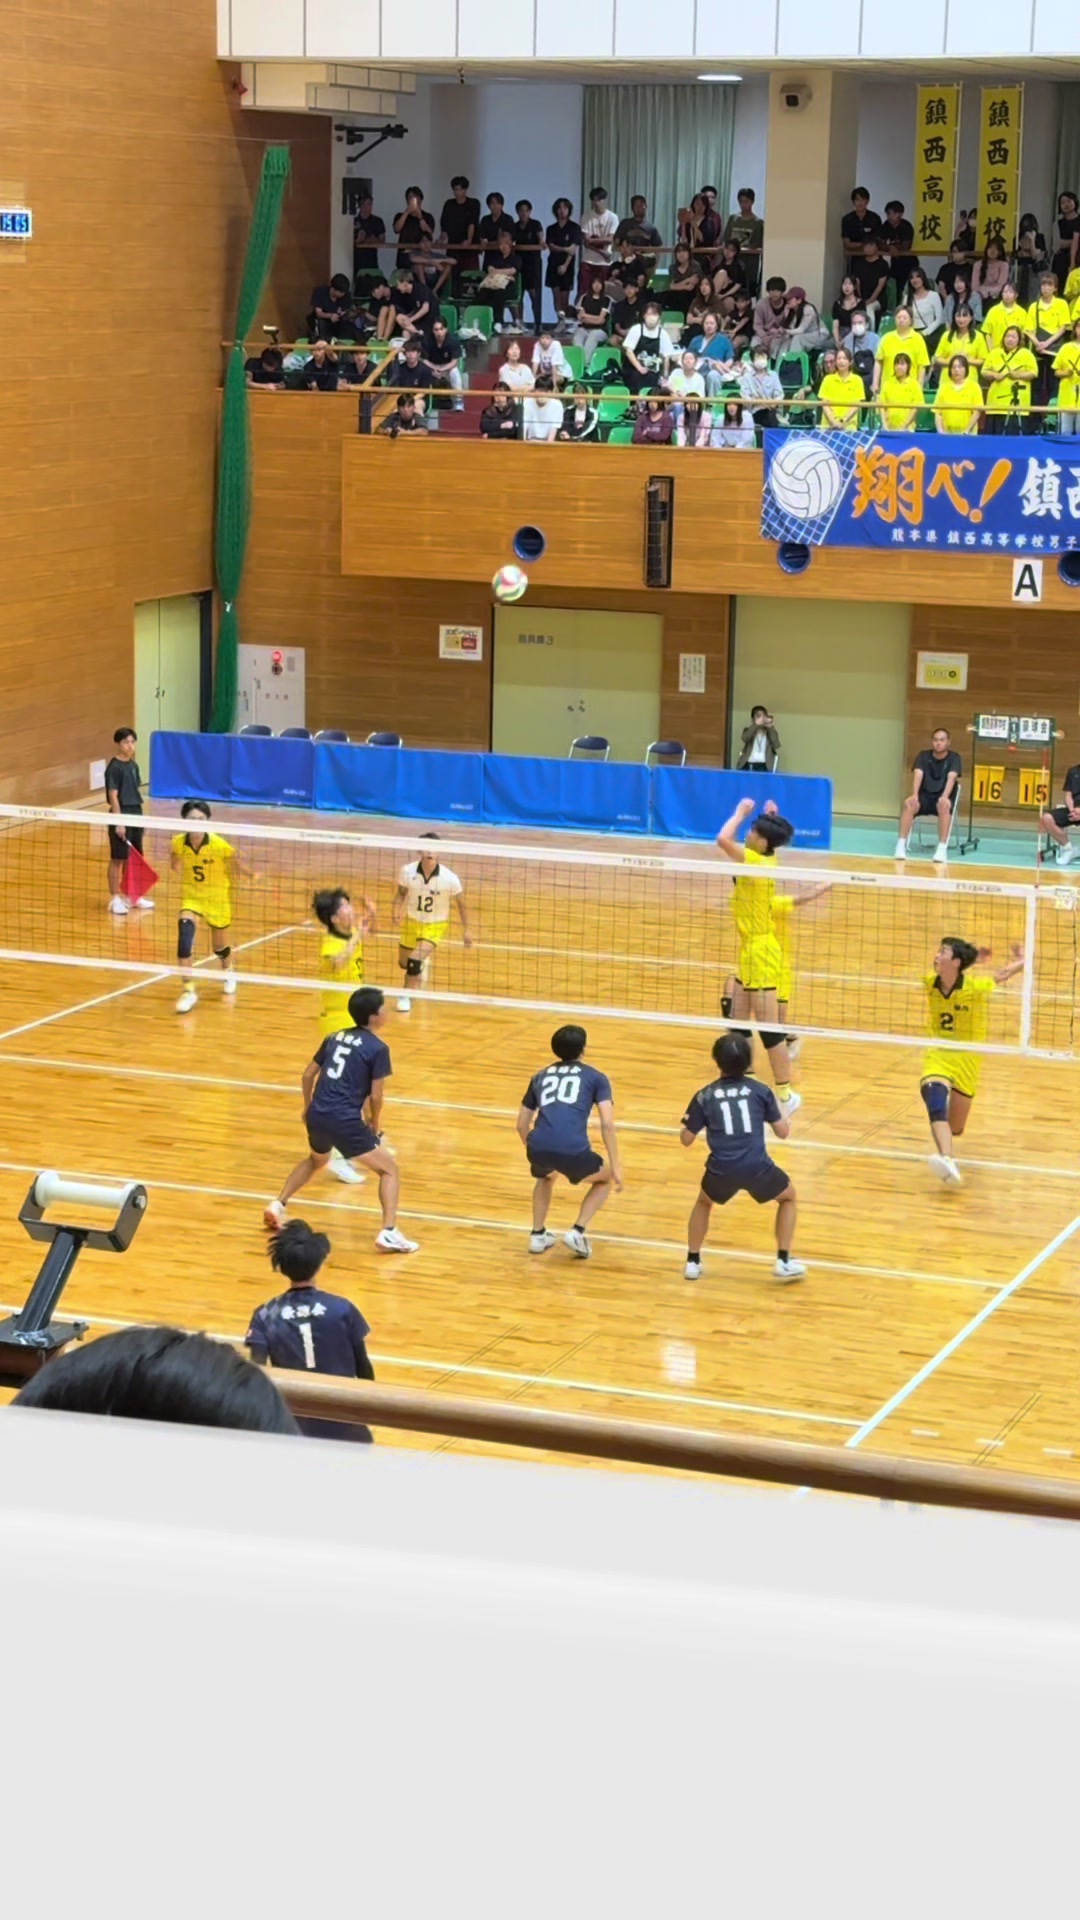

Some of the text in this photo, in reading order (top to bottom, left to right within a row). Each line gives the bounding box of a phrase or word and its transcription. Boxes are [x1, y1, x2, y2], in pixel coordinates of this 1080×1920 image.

[919, 98, 948, 241] 鎮西高校
[983, 100, 1010, 244] 鎮西高校
[1018, 456, 1080, 520] 鎮
[1014, 563, 1039, 597] A
[979, 780, 1001, 800] 16
[1024, 784, 1047, 803] 15
[192, 865, 206, 882] 5
[417, 895, 434, 912] 12
[940, 1012, 954, 1031] 2
[327, 1045, 351, 1079] 5
[540, 1075, 581, 1106] 20
[720, 1099, 752, 1135] 11
[299, 1322, 316, 1369] 1
